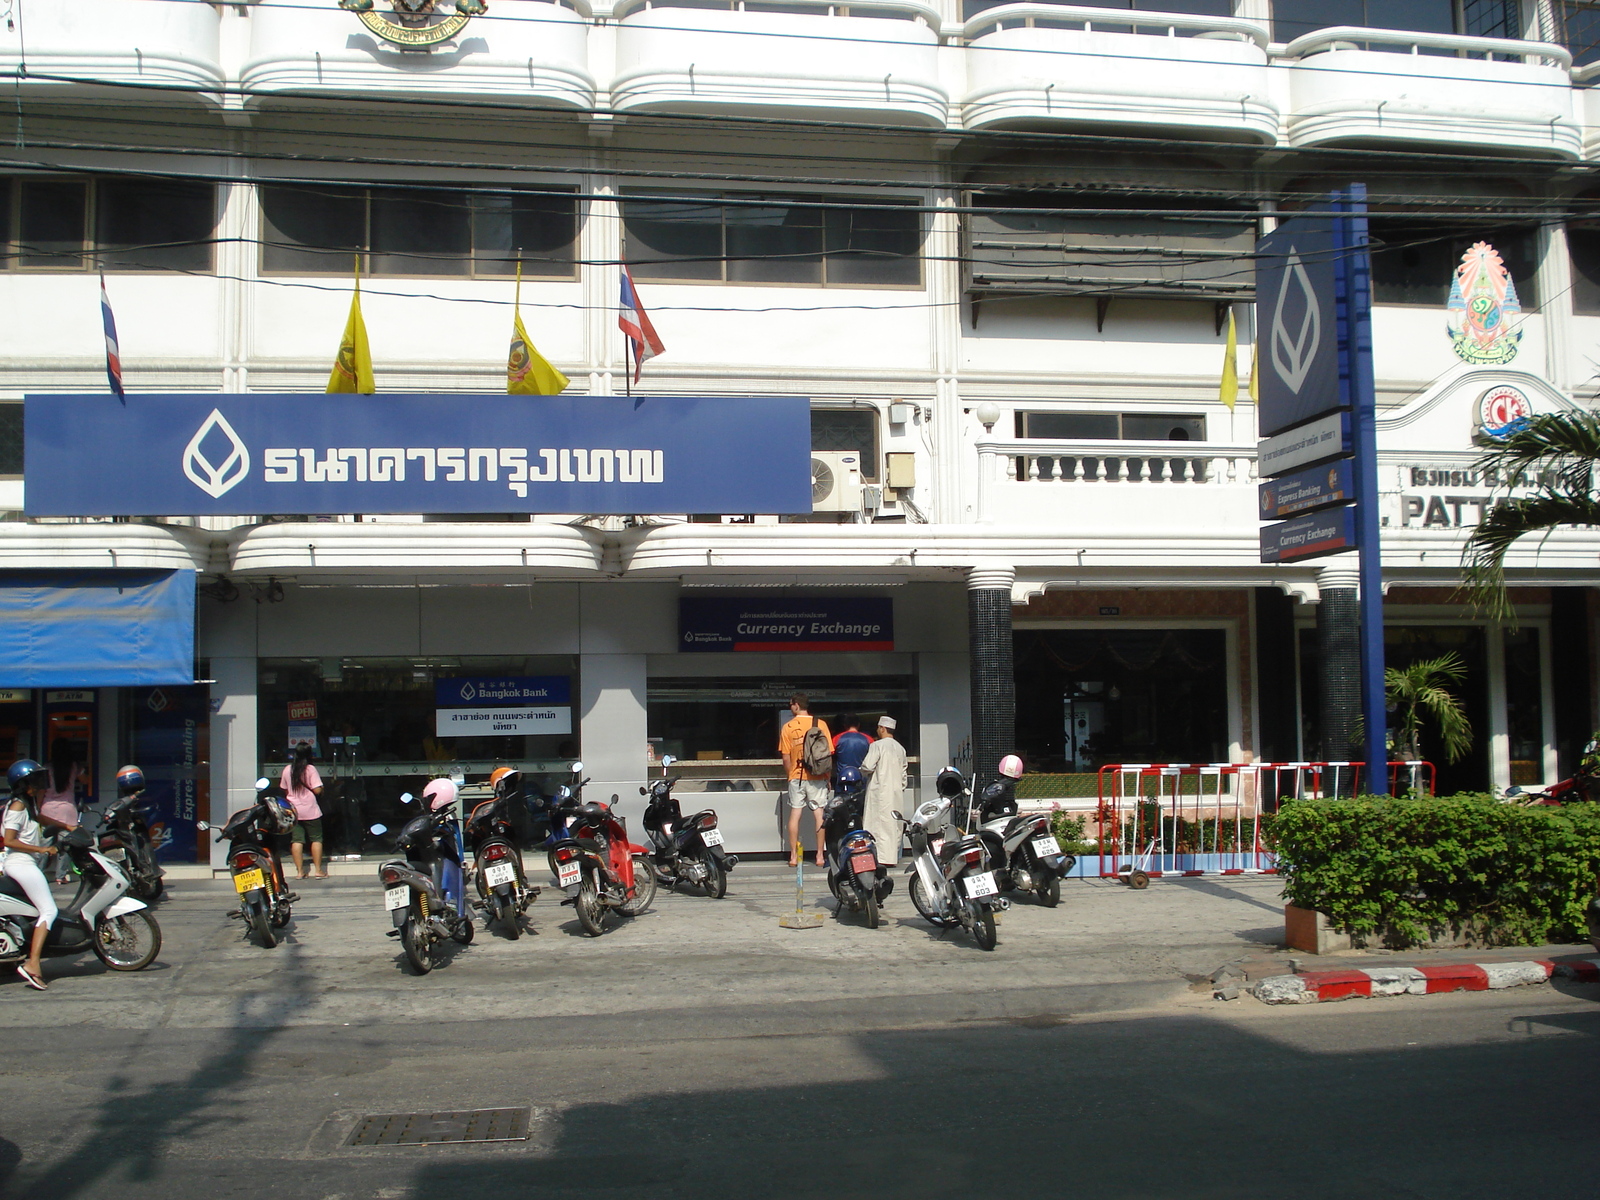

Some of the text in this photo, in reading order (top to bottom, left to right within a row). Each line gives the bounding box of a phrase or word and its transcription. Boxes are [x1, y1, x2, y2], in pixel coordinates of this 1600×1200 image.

[264, 448, 664, 498] ธนาคารกรุงเทพ
[1411, 466, 1478, 487] โรงแรม
[1278, 492, 1298, 504] Express
[1298, 485, 1321, 498] Banking
[1280, 533, 1306, 546] Currency
[1307, 526, 1336, 540] Exchange
[737, 622, 881, 636] Currency Exchange
[479, 687, 548, 699] Bangkok Bank
[291, 707, 316, 718] OPEN
[492, 722, 517, 731] พัทยา
[152, 827, 172, 840] 24
[1042, 848, 1055, 856] 625
[494, 875, 509, 884] 854
[563, 875, 578, 884] 710
[975, 887, 990, 896] 603
